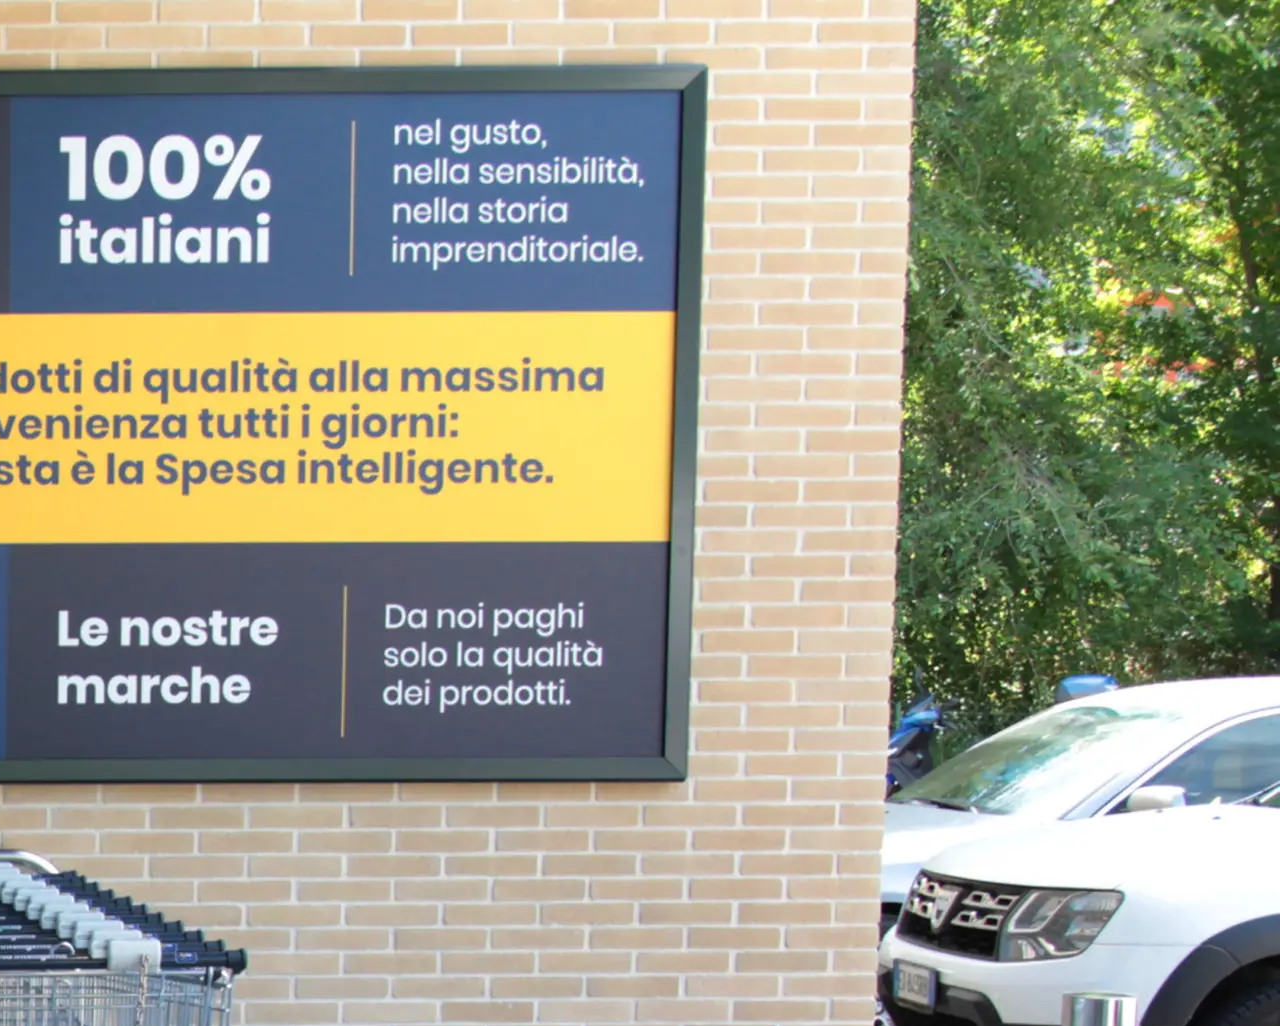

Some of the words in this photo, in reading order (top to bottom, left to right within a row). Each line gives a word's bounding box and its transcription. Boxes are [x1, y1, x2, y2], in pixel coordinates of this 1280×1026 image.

[394, 118, 441, 146] nel
[450, 119, 547, 154] gusto,
[59, 134, 271, 201] 100%
[393, 157, 470, 185] nella
[479, 156, 645, 188] sensibilità,
[392, 196, 469, 224] nella
[478, 195, 568, 224] storia
[59, 211, 271, 264] italiani
[392, 234, 644, 271] imprenditoriale.
[93, 357, 132, 394] di
[143, 357, 298, 405] qualità
[308, 359, 389, 393] alla
[400, 356, 605, 393] massima
[198, 403, 290, 439] tutti
[301, 403, 311, 439] i
[321, 403, 459, 450] giorni:
[70, 449, 96, 485] è
[106, 452, 144, 485] la
[155, 453, 285, 497] Spesa
[297, 448, 554, 496] intelligente.
[58, 610, 109, 647] Le
[120, 610, 279, 647] nostre
[385, 603, 428, 629] Da
[437, 601, 484, 629] noi
[493, 601, 584, 637] paghi
[383, 641, 448, 668] solo
[456, 641, 484, 668] la
[492, 640, 603, 675] qualità
[57, 665, 252, 705] marche
[382, 678, 431, 706] dei
[439, 678, 571, 714] prodotti.
